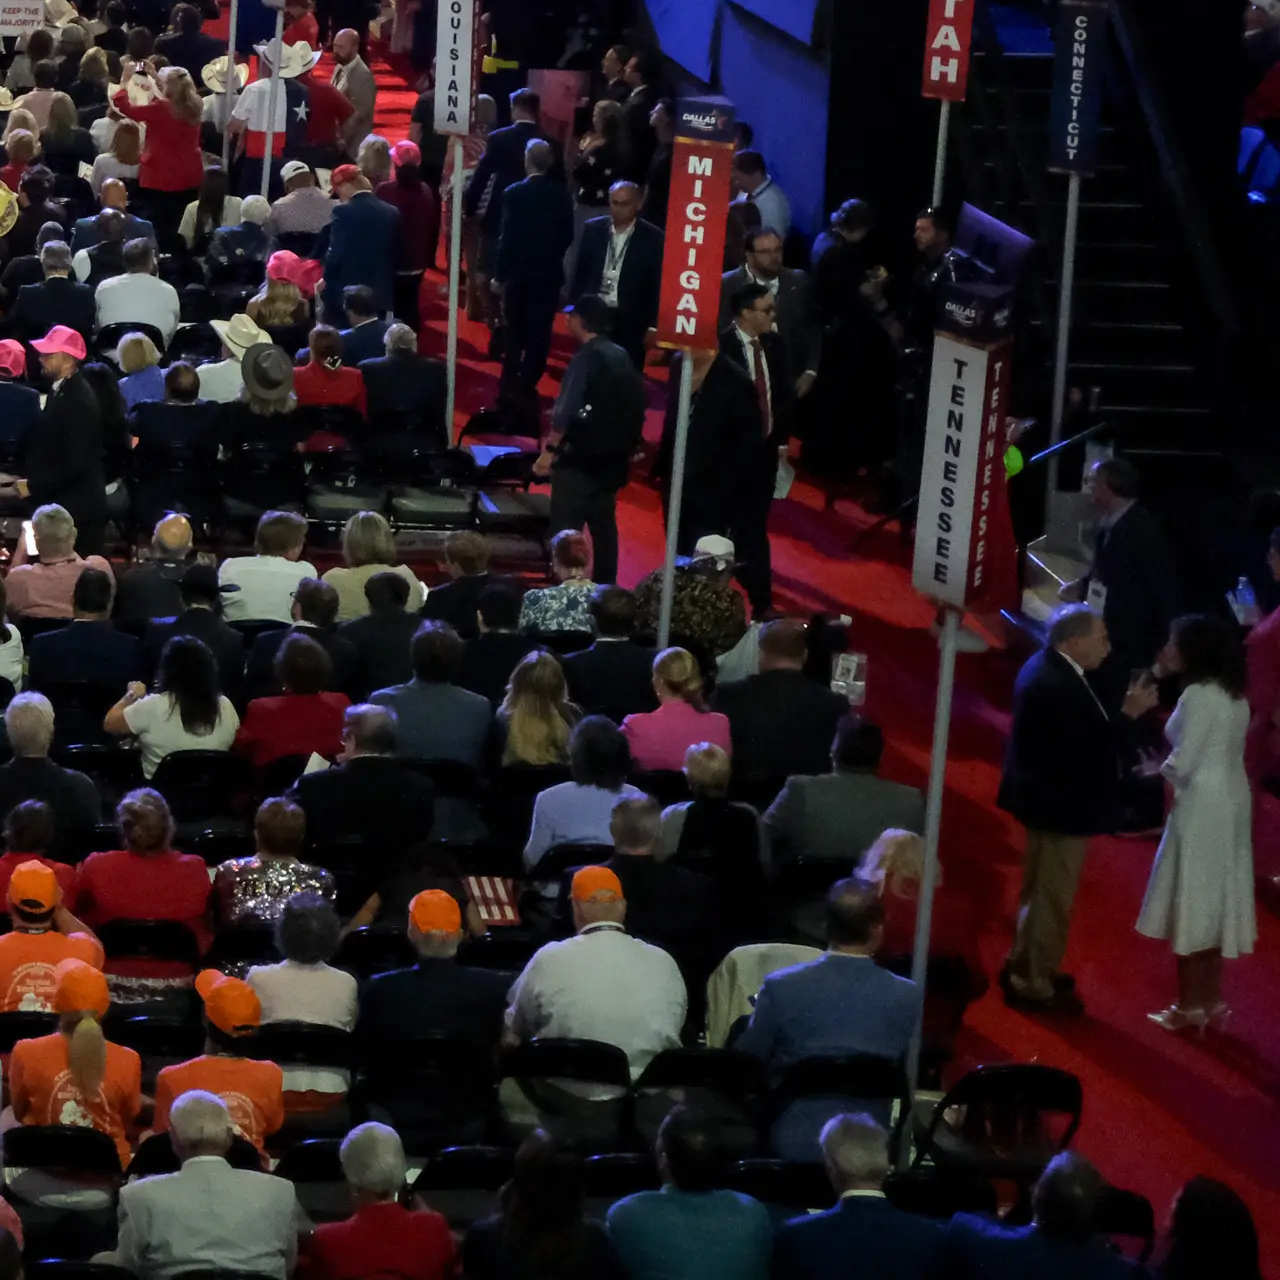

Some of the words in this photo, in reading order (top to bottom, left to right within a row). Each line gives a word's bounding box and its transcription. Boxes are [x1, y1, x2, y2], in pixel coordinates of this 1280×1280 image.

[682, 113, 716, 125] DALLAS
[1066, 15, 1088, 160] CONNECTICUT
[675, 155, 712, 336] MICHIGAN
[944, 301, 976, 319] DALLAS
[933, 357, 968, 586] TENNESSEE
[973, 361, 1003, 588] TENNESSEE
